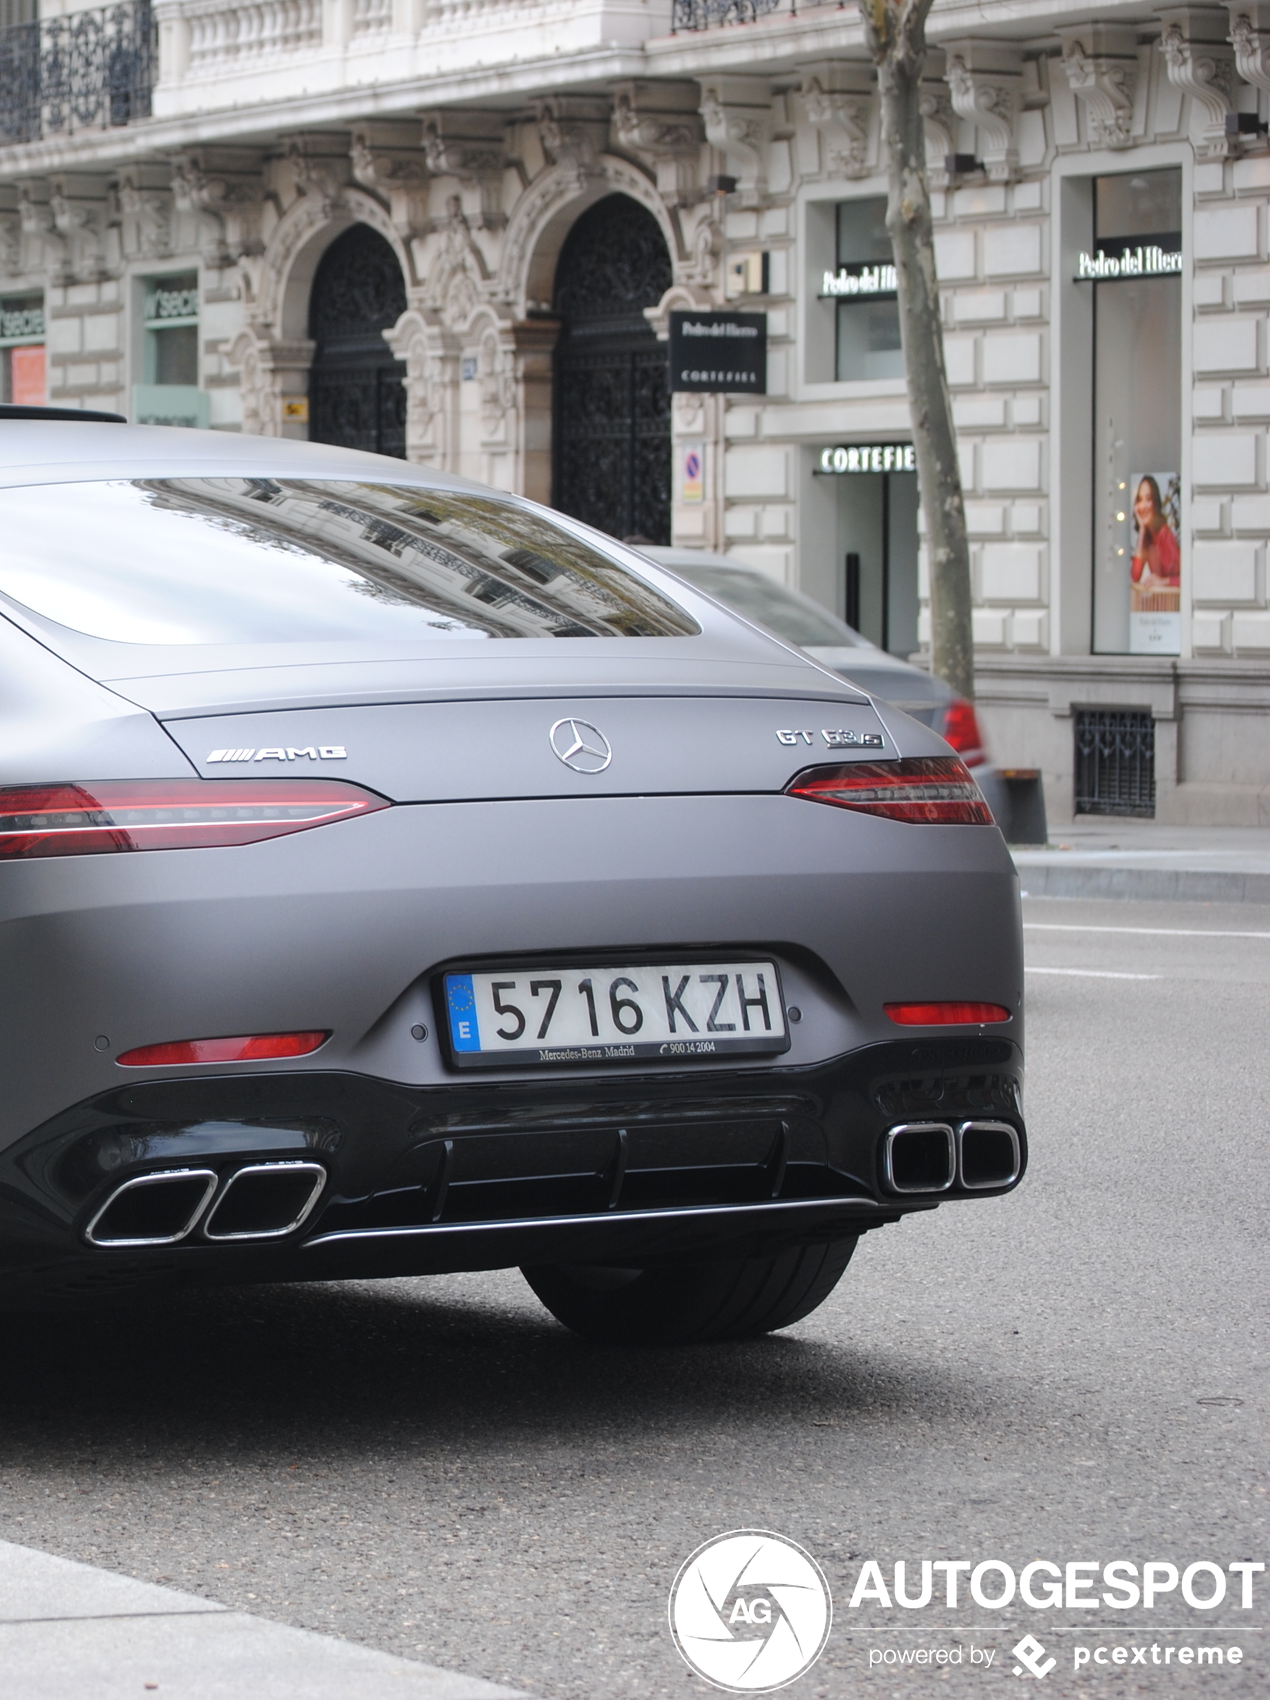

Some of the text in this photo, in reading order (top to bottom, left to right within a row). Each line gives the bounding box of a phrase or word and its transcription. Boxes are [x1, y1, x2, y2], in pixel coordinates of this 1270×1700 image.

[1077, 249, 1120, 279] Pedro
[1120, 246, 1143, 276] del
[822, 267, 859, 297] Pedro
[681, 369, 757, 384] CORTEFIEL
[776, 728, 814, 746] GT
[254, 745, 348, 762] AMG
[458, 972, 773, 1042] E 5716 KZH
[538, 1040, 716, 1062] Mercedes-Benz Madrid 900 14 2004
